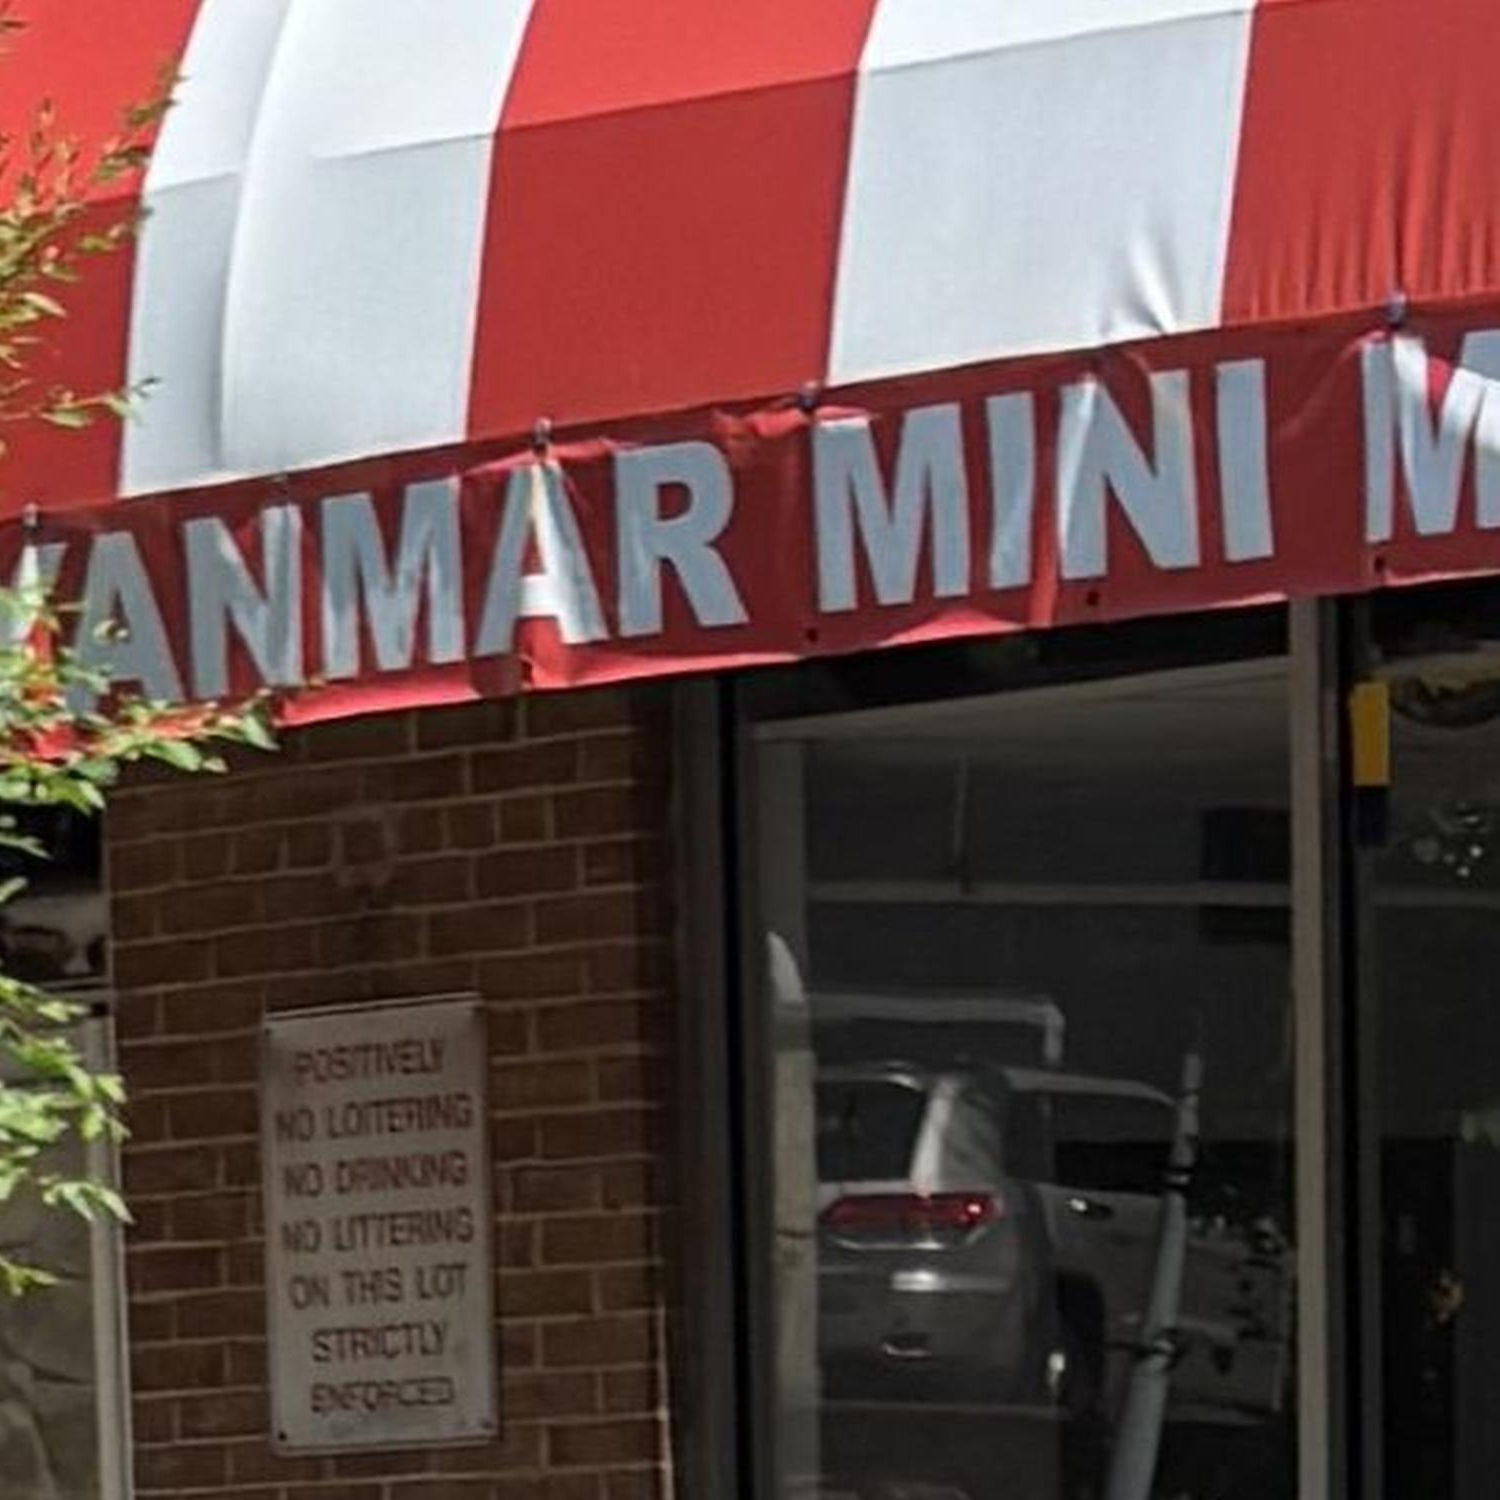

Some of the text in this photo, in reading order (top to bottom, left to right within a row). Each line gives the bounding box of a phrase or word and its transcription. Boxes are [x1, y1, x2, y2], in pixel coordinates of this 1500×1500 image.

[812, 359, 1274, 613] MINI
[294, 1037, 446, 1085] POSITIVELY
[275, 1093, 473, 1142] NO LOITERING
[284, 1149, 468, 1197] NO DRINKING
[281, 1207, 476, 1253] NO LITTERING
[289, 1262, 469, 1310] ON THIS LOT
[311, 1320, 447, 1363] STRICTLY
[311, 1376, 456, 1414] ENFORCED
